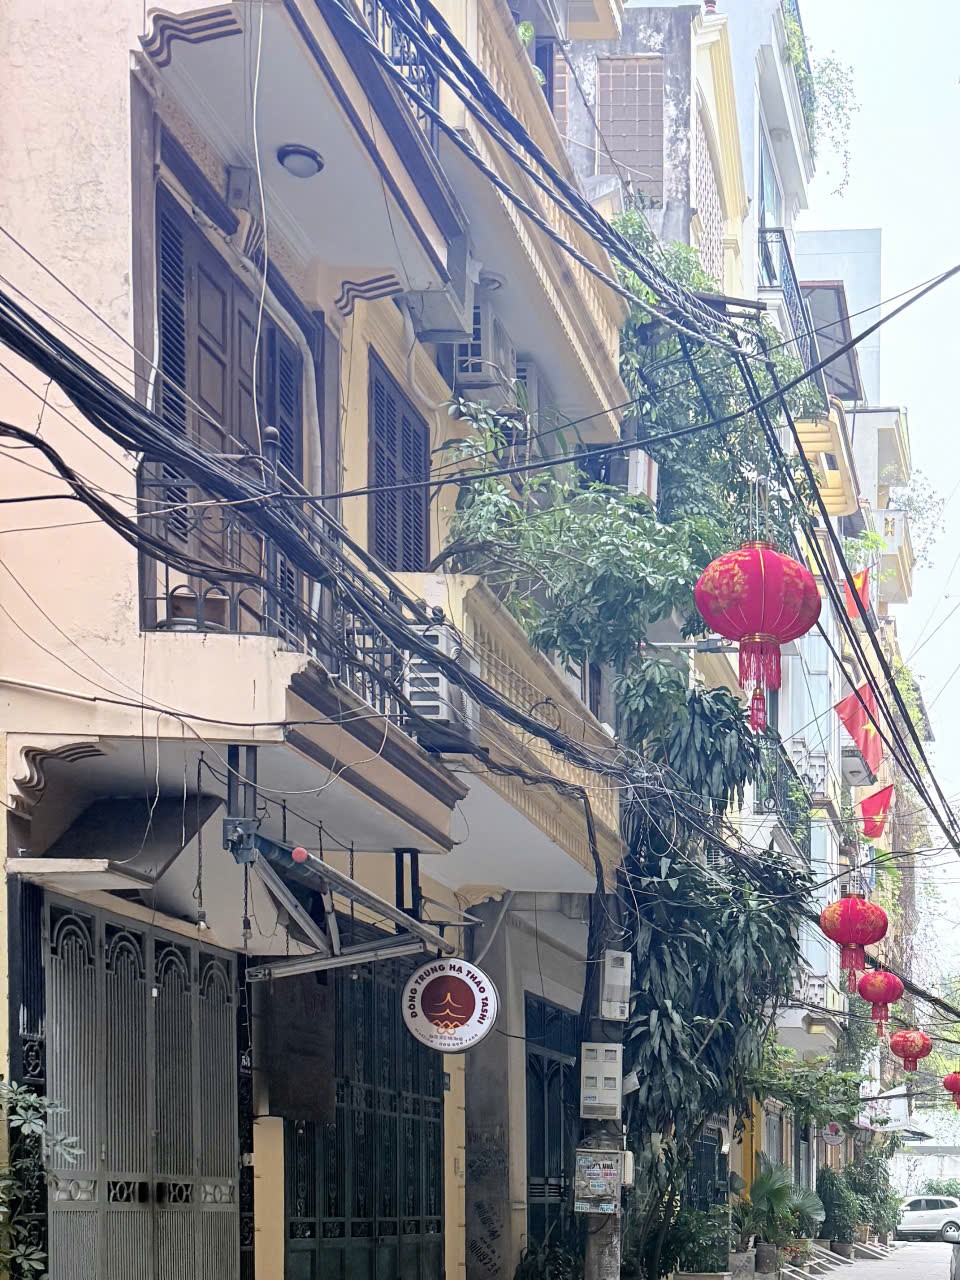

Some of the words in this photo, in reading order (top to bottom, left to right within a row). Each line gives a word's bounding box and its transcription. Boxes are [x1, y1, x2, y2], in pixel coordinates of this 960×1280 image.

[414, 964, 445, 986] TRUNG
[449, 964, 463, 974] HẠ
[465, 970, 486, 994] THẢO
[477, 996, 489, 1025] TASHI
